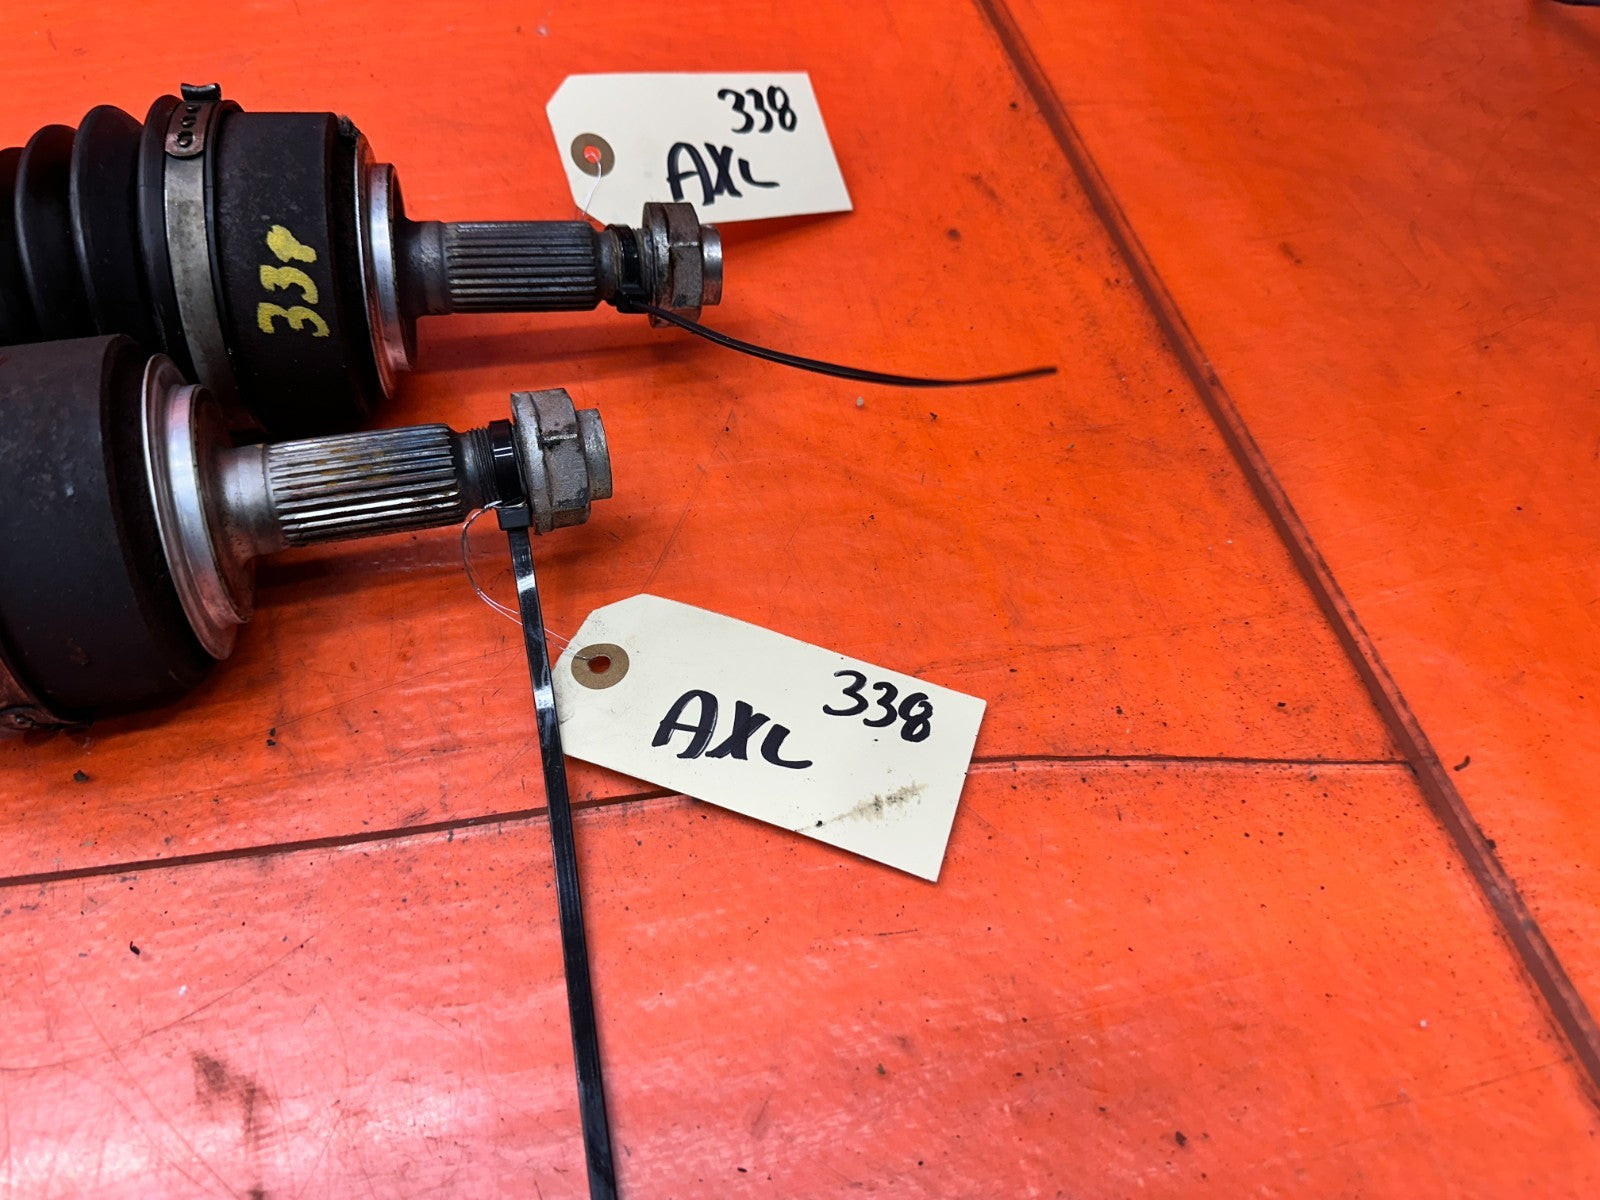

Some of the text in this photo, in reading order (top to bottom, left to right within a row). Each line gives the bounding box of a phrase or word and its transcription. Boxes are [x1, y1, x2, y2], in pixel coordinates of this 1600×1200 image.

[718, 85, 797, 134] 338
[666, 142, 780, 206] AXL
[651, 689, 813, 769] AXL
[822, 669, 934, 743] 338
